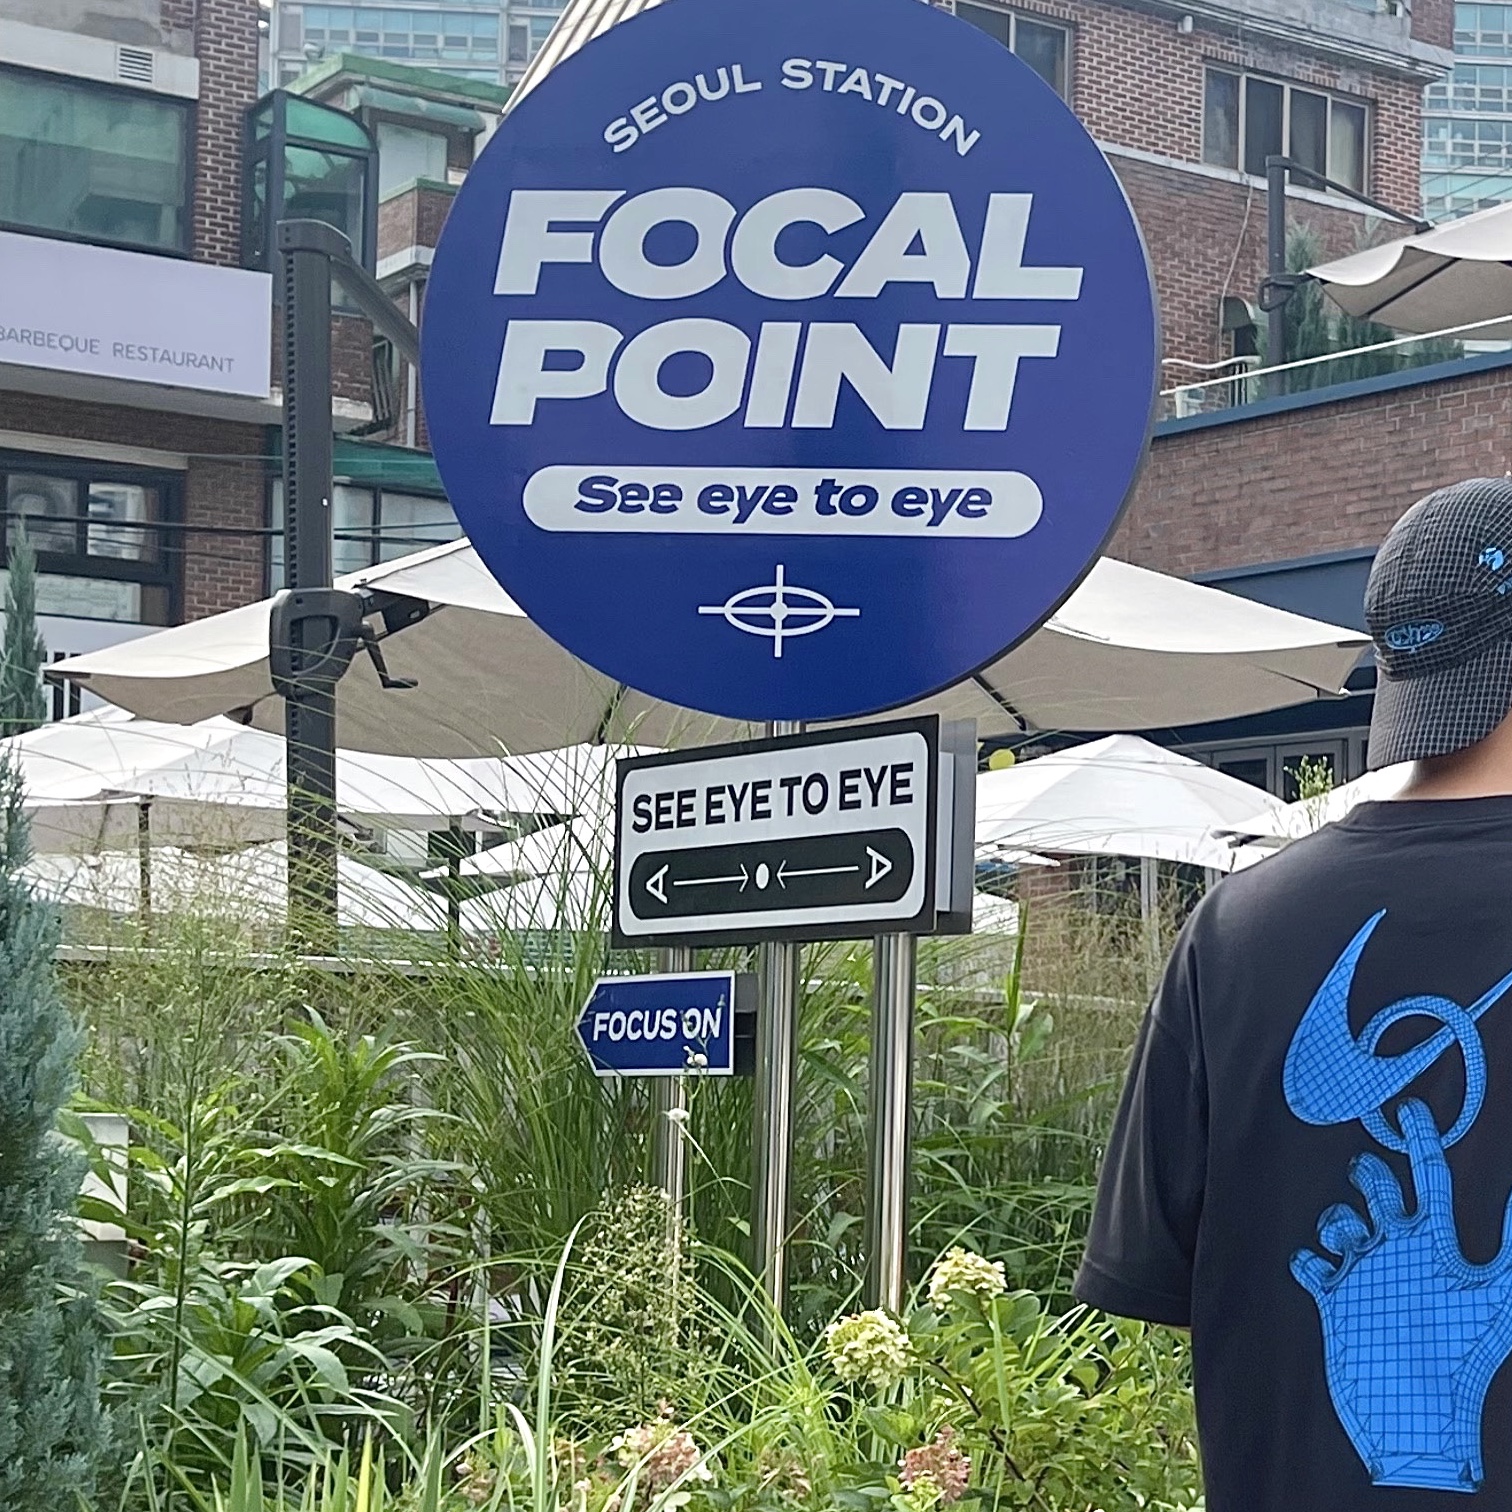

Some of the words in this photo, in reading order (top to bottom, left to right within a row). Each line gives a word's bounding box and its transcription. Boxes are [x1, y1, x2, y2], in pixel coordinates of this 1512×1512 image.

[603, 63, 762, 153] SEOUL
[780, 58, 981, 157] STATION
[493, 187, 1084, 301] FOCAL
[113, 342, 235, 373] RESTAURANT
[489, 317, 1062, 431] POINT
[574, 476, 683, 515] See
[696, 483, 798, 524] eye
[814, 479, 879, 517] to
[891, 485, 992, 527] eye
[632, 789, 697, 833] SEE
[705, 779, 772, 825] EYE
[780, 773, 828, 816] TO
[839, 762, 914, 811] EYE
[593, 1008, 678, 1041] FOCUS
[682, 1007, 722, 1040] ON
